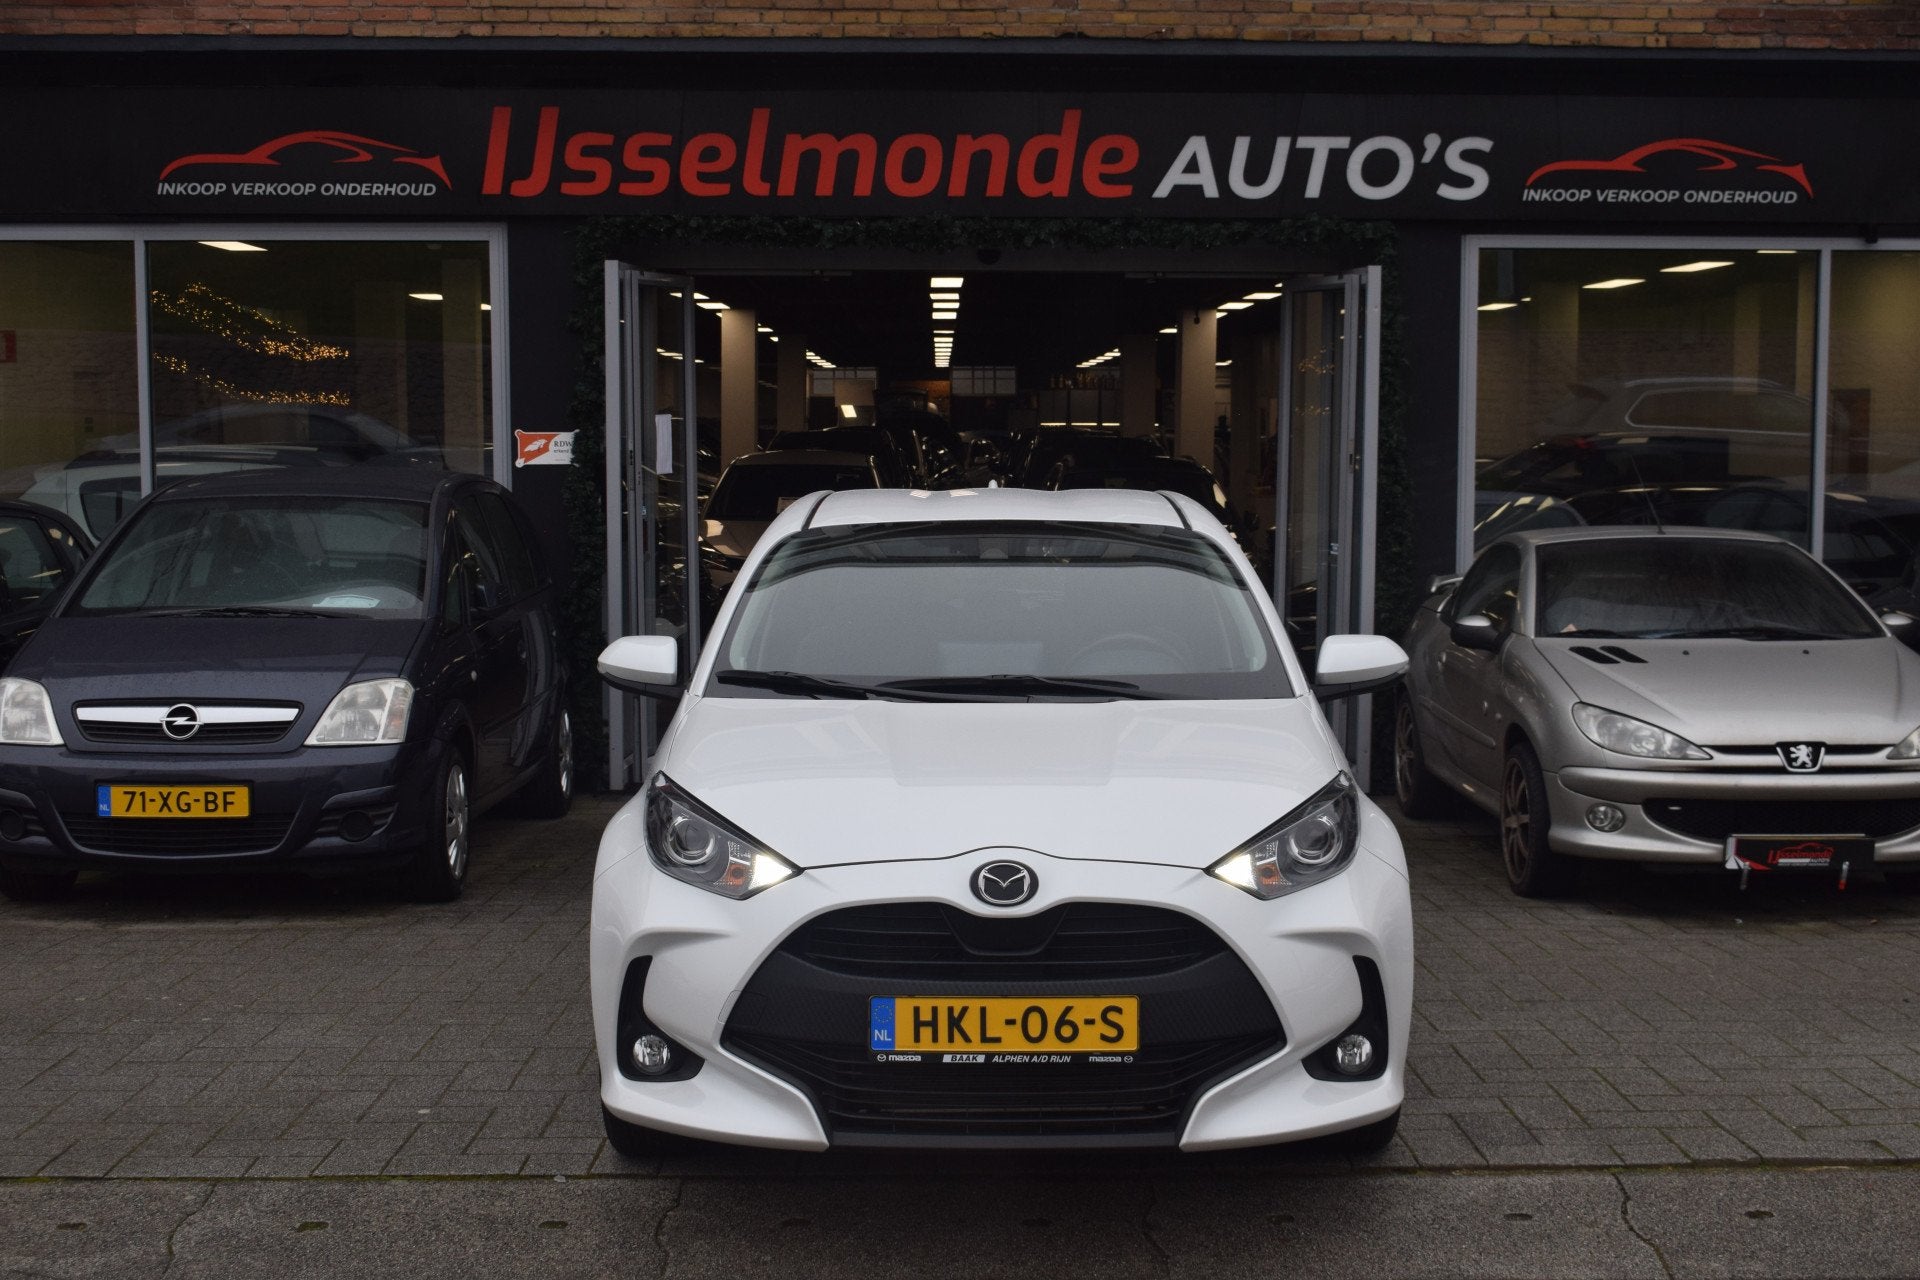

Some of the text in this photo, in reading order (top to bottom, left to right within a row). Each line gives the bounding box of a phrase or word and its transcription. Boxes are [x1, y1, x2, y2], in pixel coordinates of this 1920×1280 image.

[481, 106, 1495, 200] IJsselmonde AUTO'S
[157, 182, 437, 197] INKOOP VERKOOP ONDERHOUD
[1522, 188, 1798, 204] INKOOP VERKOOP ONDERHOUD
[122, 791, 236, 813] 71-XG-BF
[912, 1005, 1125, 1044] HKL-06-S
[873, 1029, 892, 1042] NL
[888, 1054, 922, 1062] mazda
[950, 1054, 979, 1063] BAAK
[991, 1055, 1072, 1063] ALPHEN A/D RIJN
[1088, 1055, 1122, 1063] mazda
